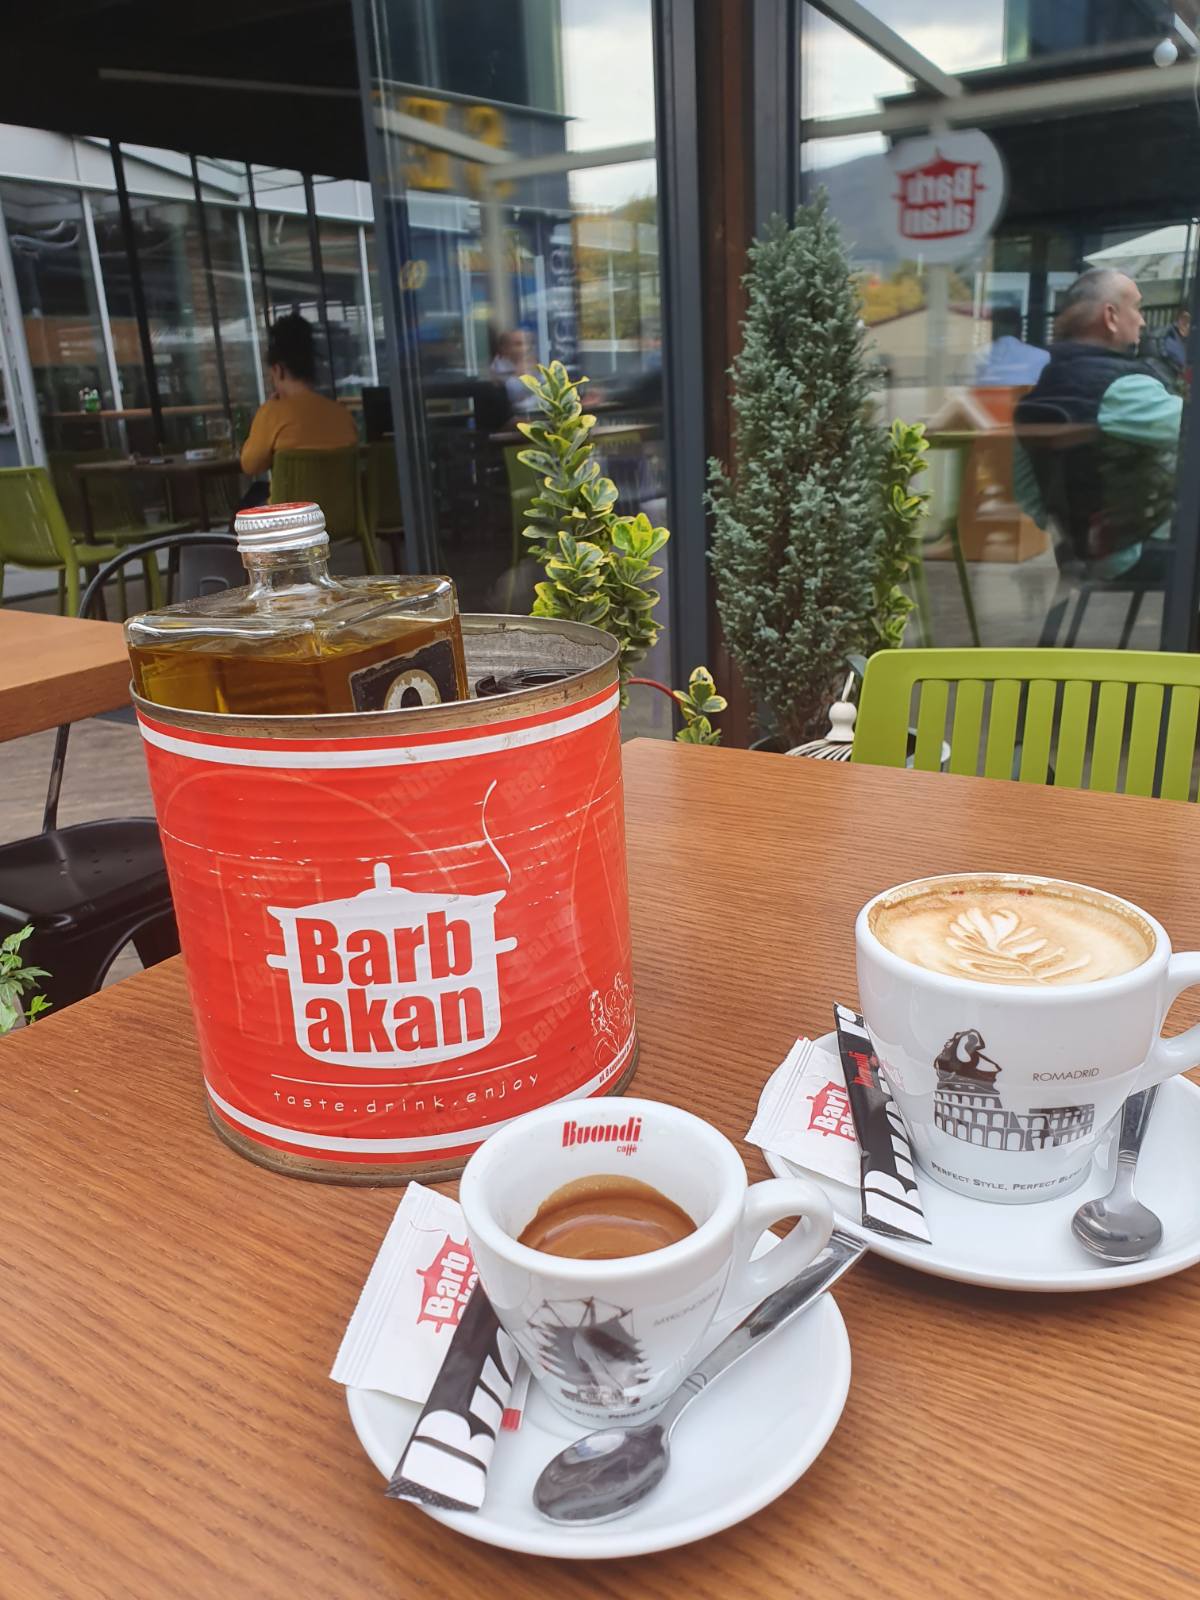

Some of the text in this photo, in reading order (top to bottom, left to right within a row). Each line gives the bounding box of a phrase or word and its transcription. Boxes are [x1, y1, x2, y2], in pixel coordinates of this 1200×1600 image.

[296, 911, 473, 986] Barb
[305, 987, 485, 1053] akan
[1032, 1067, 1100, 1082] ROMADRID
[562, 1116, 642, 1147] Buondi
[423, 1251, 471, 1319] Barb
